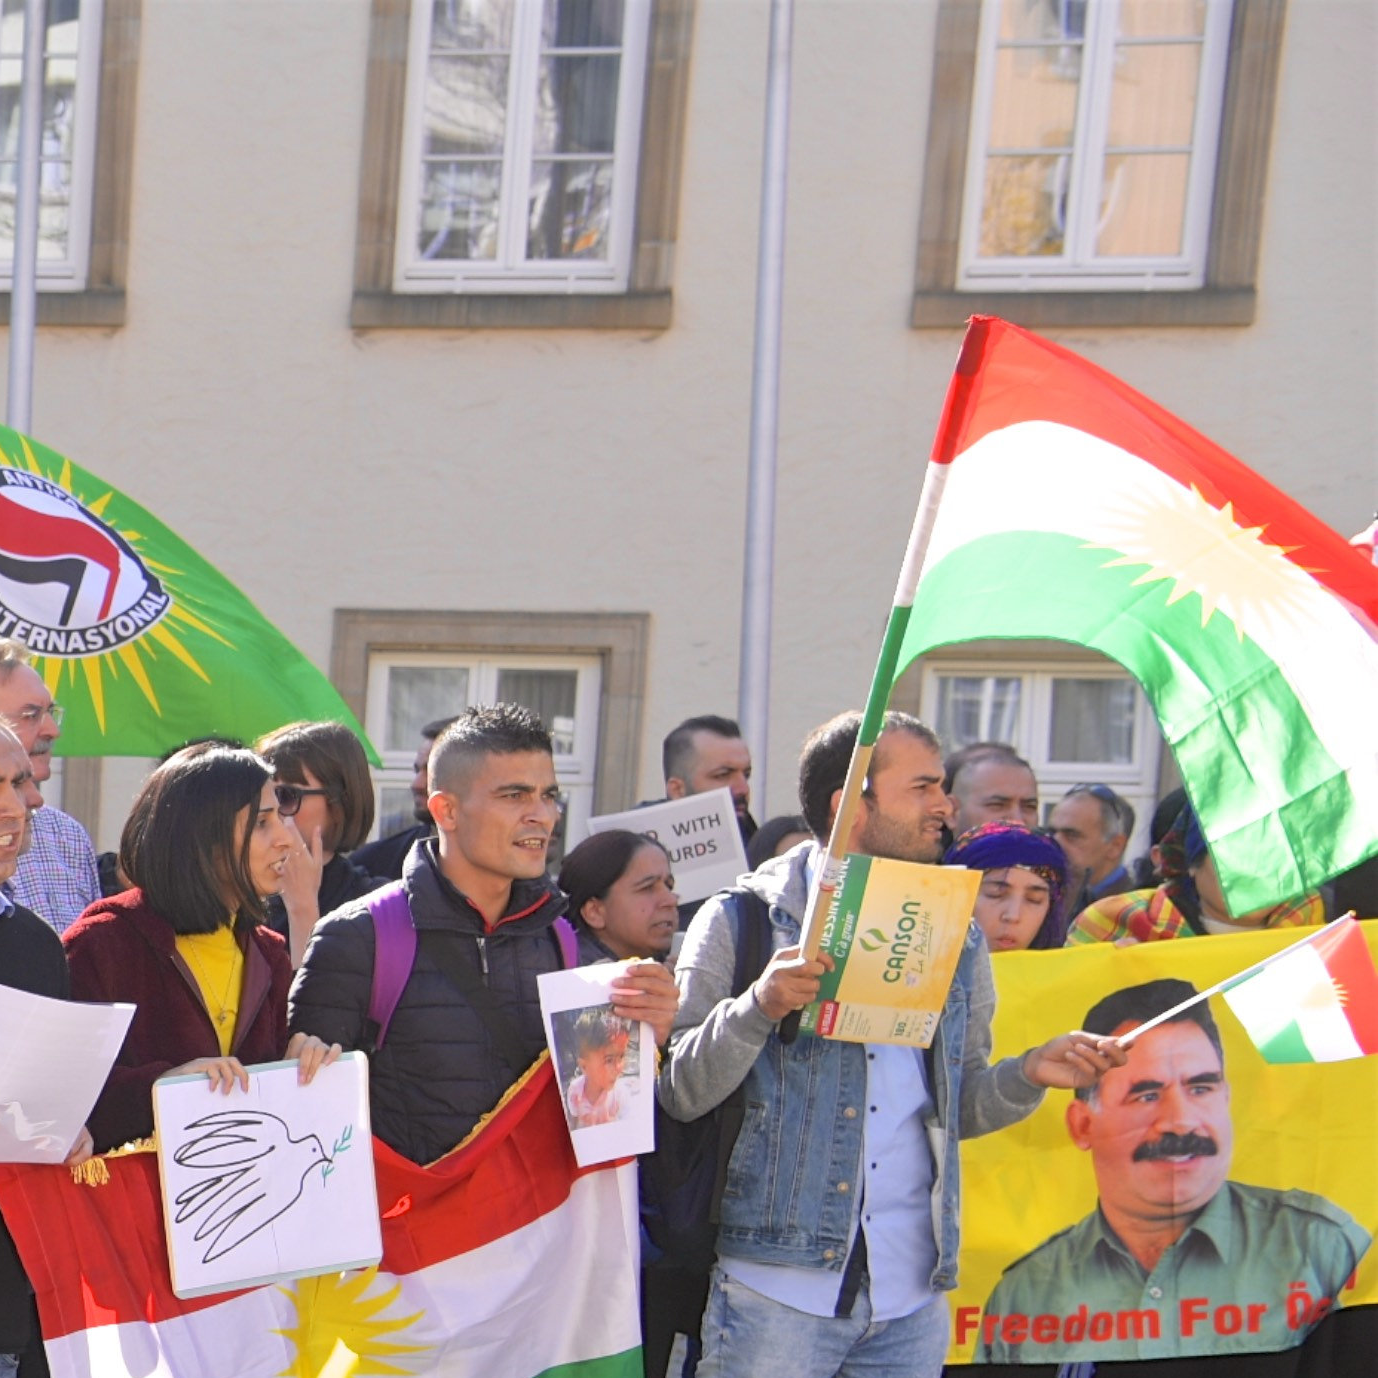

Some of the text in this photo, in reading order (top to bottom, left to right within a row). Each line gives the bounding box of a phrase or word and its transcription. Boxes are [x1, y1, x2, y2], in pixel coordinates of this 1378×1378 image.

[672, 813, 721, 837] WITH
[669, 839, 718, 863] URDS
[882, 901, 922, 983] CANSON
[955, 1304, 1161, 1345] Freedom
[1179, 1298, 1267, 1338] For
